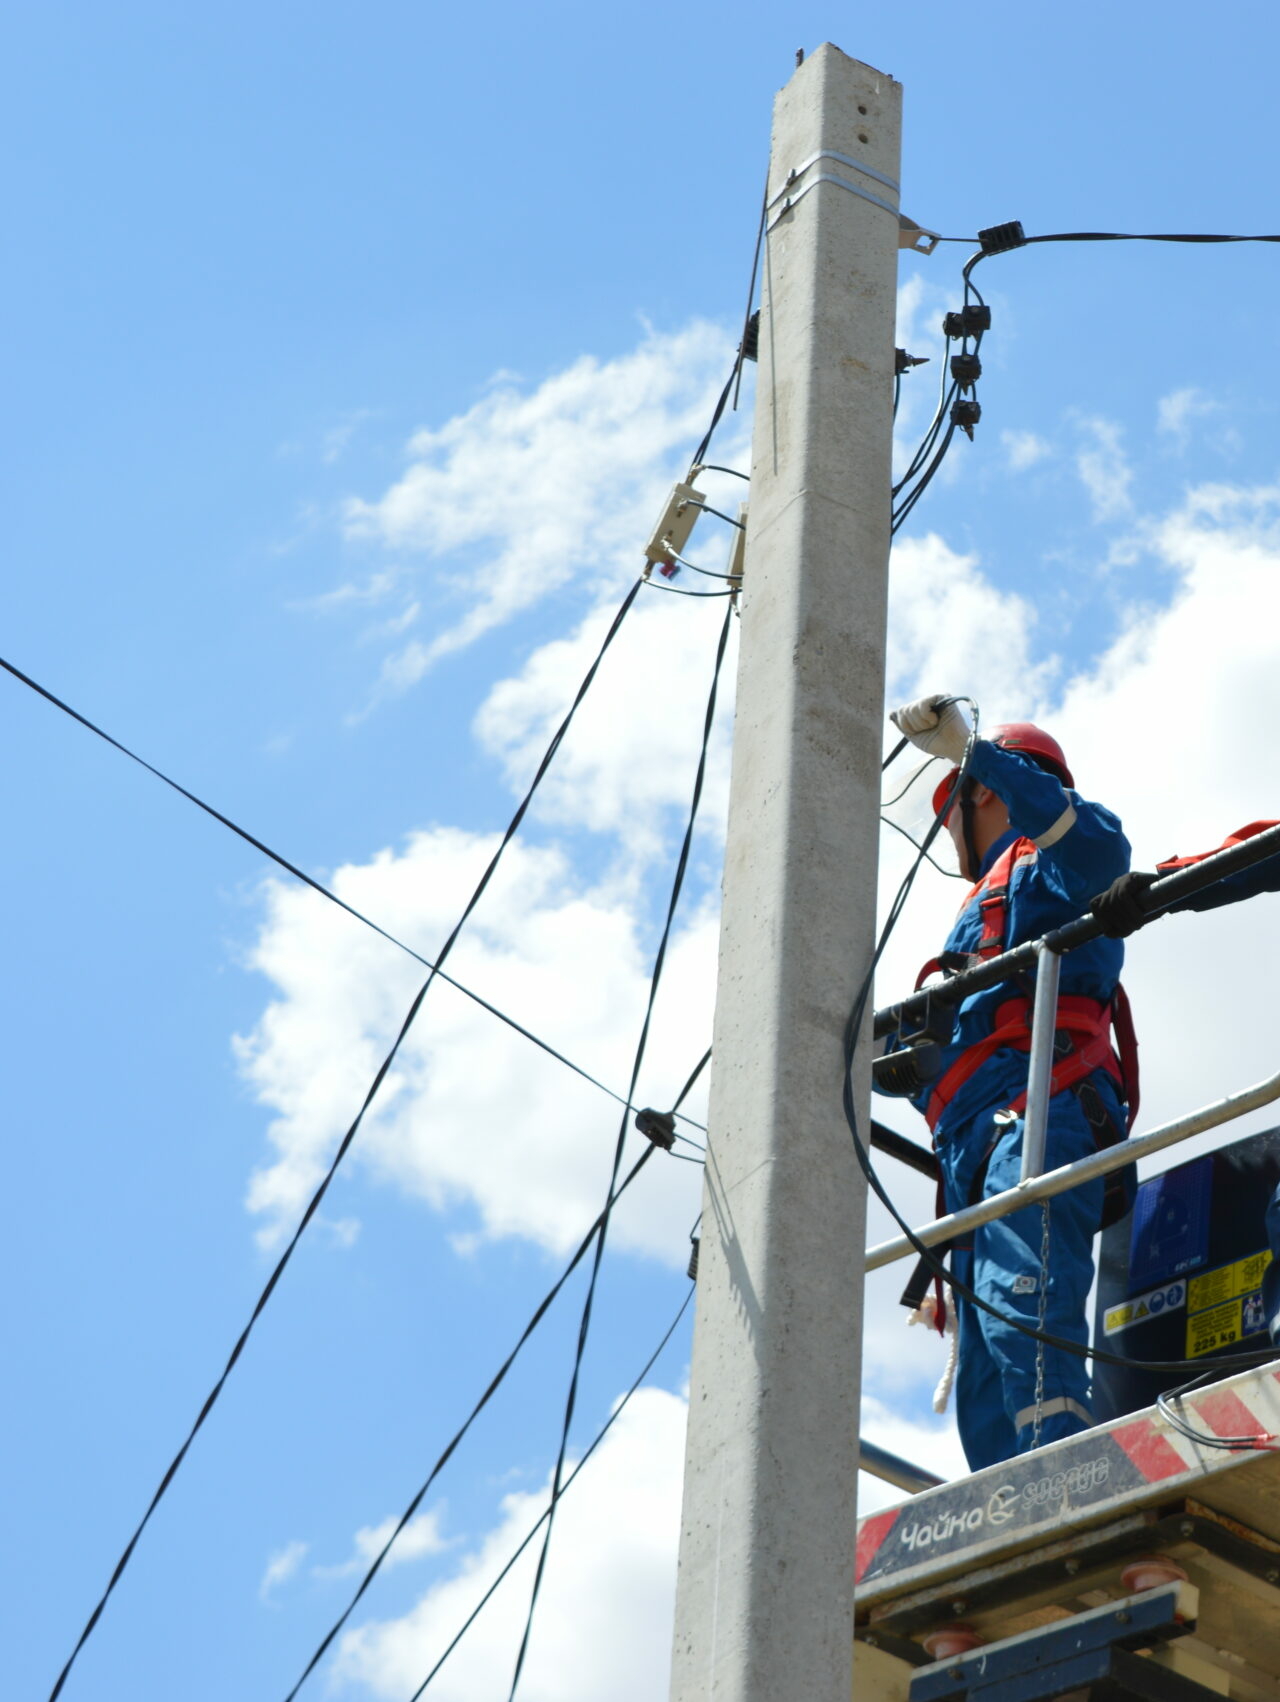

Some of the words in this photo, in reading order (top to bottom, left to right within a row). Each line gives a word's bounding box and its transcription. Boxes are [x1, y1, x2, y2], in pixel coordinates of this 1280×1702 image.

[1194, 1336, 1216, 1353] 225
[1220, 1331, 1236, 1343] kg
[901, 1506, 983, 1550] Чайка
